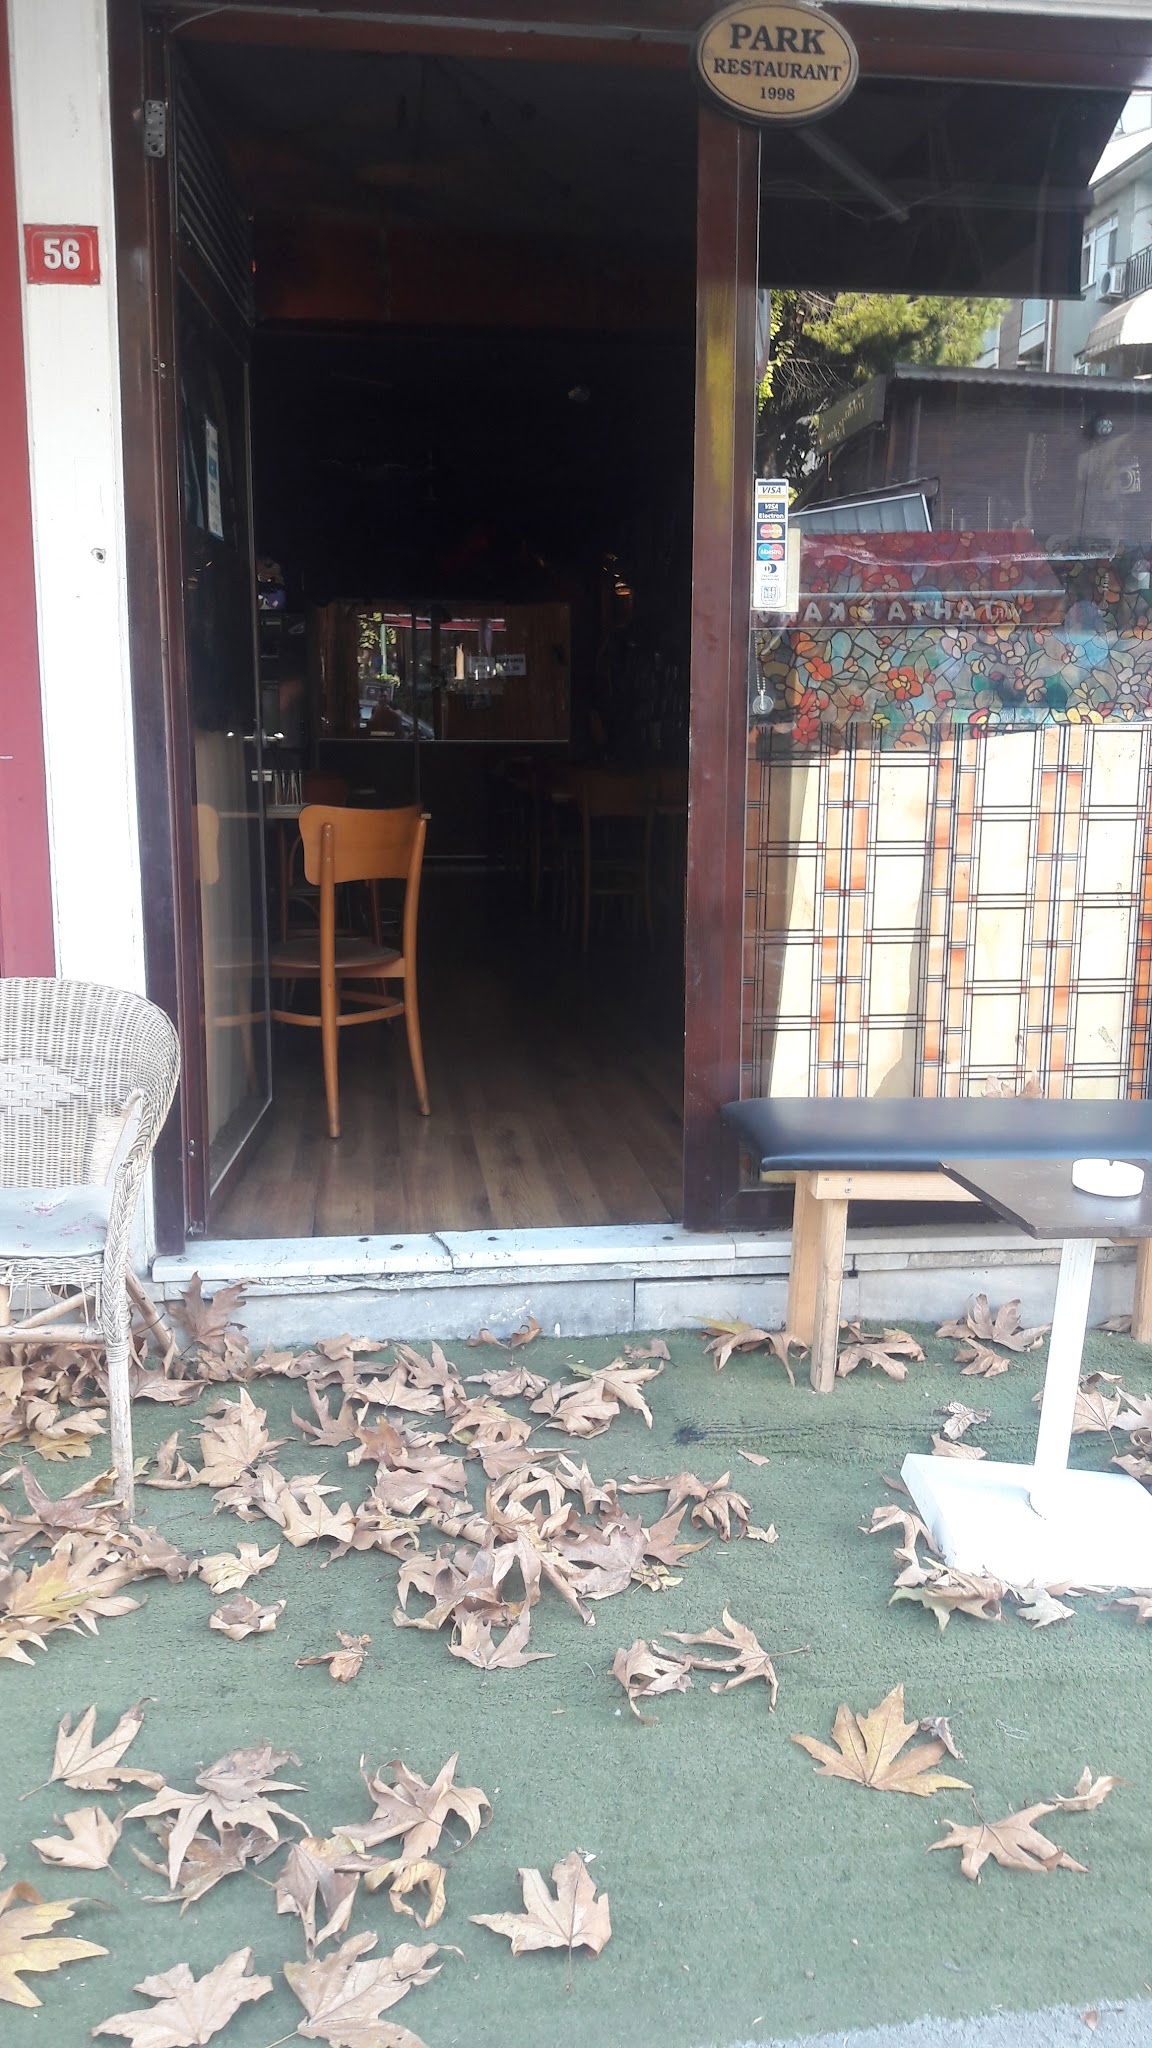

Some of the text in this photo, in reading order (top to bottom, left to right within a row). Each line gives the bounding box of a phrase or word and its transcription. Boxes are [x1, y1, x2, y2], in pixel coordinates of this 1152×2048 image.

[729, 23, 826, 55] PARK
[713, 57, 842, 82] RESTAURANT
[760, 87, 796, 101] 1998
[43, 238, 80, 270] 56
[762, 486, 781, 494] VISA
